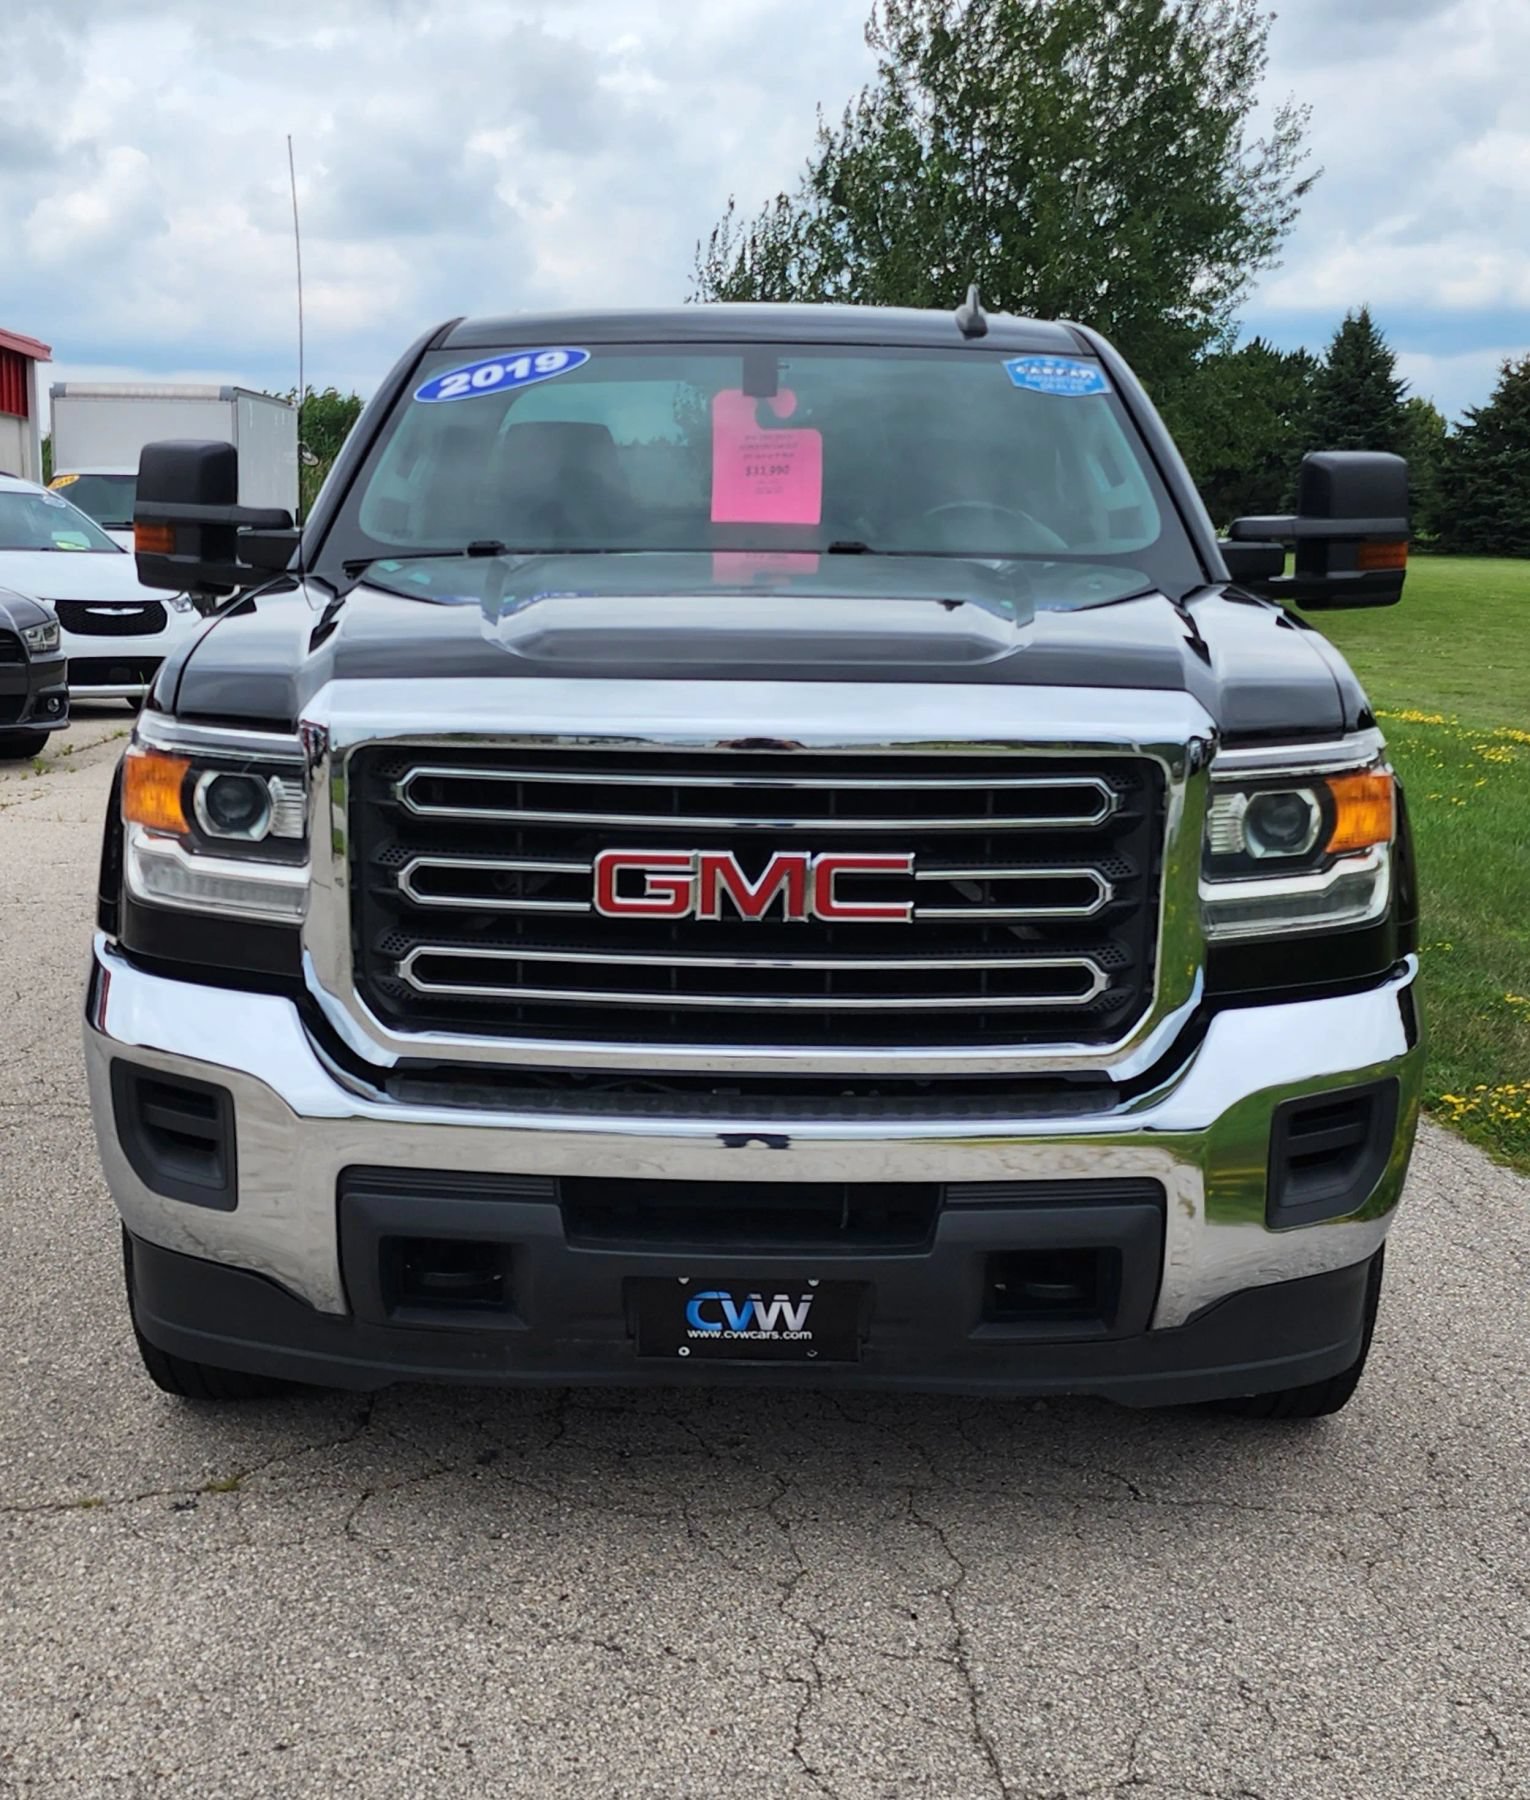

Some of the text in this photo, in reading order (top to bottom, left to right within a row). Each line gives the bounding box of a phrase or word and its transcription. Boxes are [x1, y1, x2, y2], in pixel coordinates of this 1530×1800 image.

[436, 351, 570, 400] 2019
[593, 848, 916, 923] GMC
[685, 1290, 814, 1331] CVW
[687, 1329, 813, 1341] www.cvwcars.com
